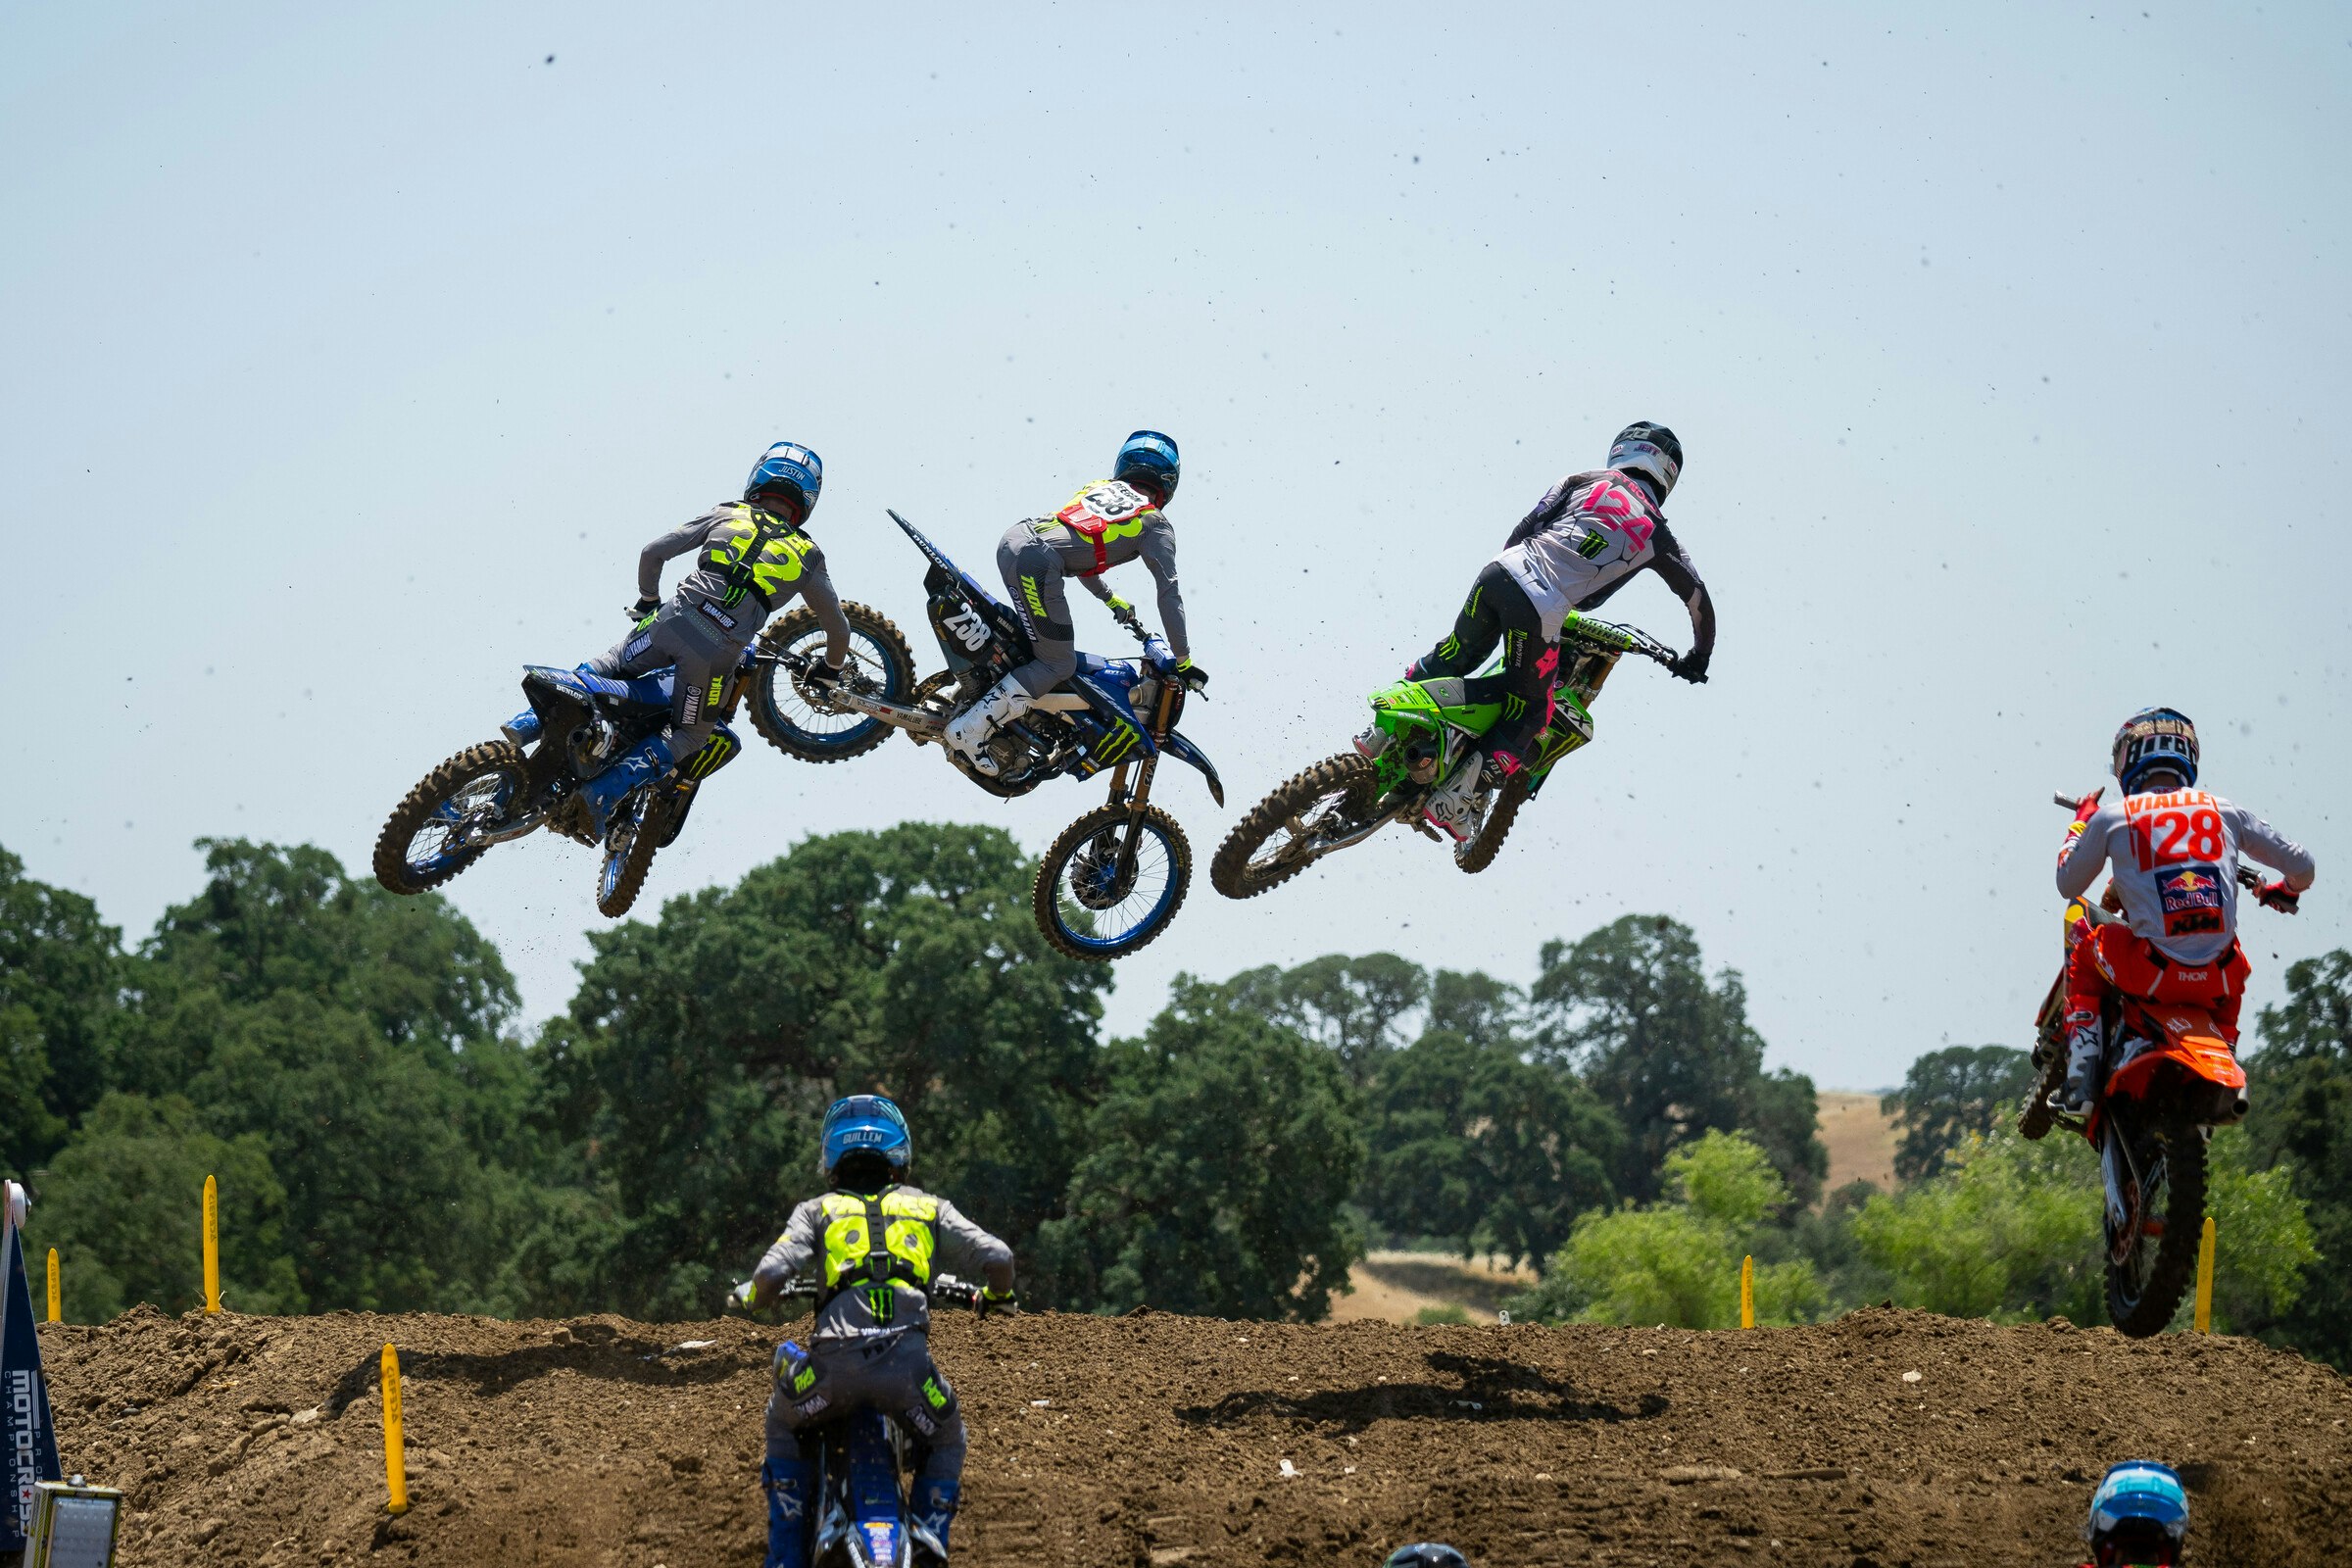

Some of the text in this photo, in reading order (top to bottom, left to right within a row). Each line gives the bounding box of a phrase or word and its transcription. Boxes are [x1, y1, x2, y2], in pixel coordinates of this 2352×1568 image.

[778, 466, 806, 481] JUSTIN
[1582, 480, 1656, 554] 124
[911, 534, 949, 570] DUNLOP
[1020, 574, 1048, 618] THOR
[943, 602, 992, 652] 238
[1012, 599, 1037, 643] YAMAHA
[556, 683, 583, 701] DUNLOP
[707, 674, 723, 707] THOR
[682, 694, 700, 725] YAMAHA
[896, 711, 923, 724] YAMALUBE
[1554, 697, 1593, 728] KX
[1486, 759, 1502, 775] FOX
[2128, 791, 2212, 815] VIALLE
[2131, 808, 2224, 872] 128
[2165, 891, 2219, 912] Red Bull
[2179, 971, 2208, 982] THOR
[843, 1131, 883, 1145] GUILLEM
[4, 1370, 20, 1539] CHAMPIONSHIP
[34, 1431, 43, 1478] PRO
